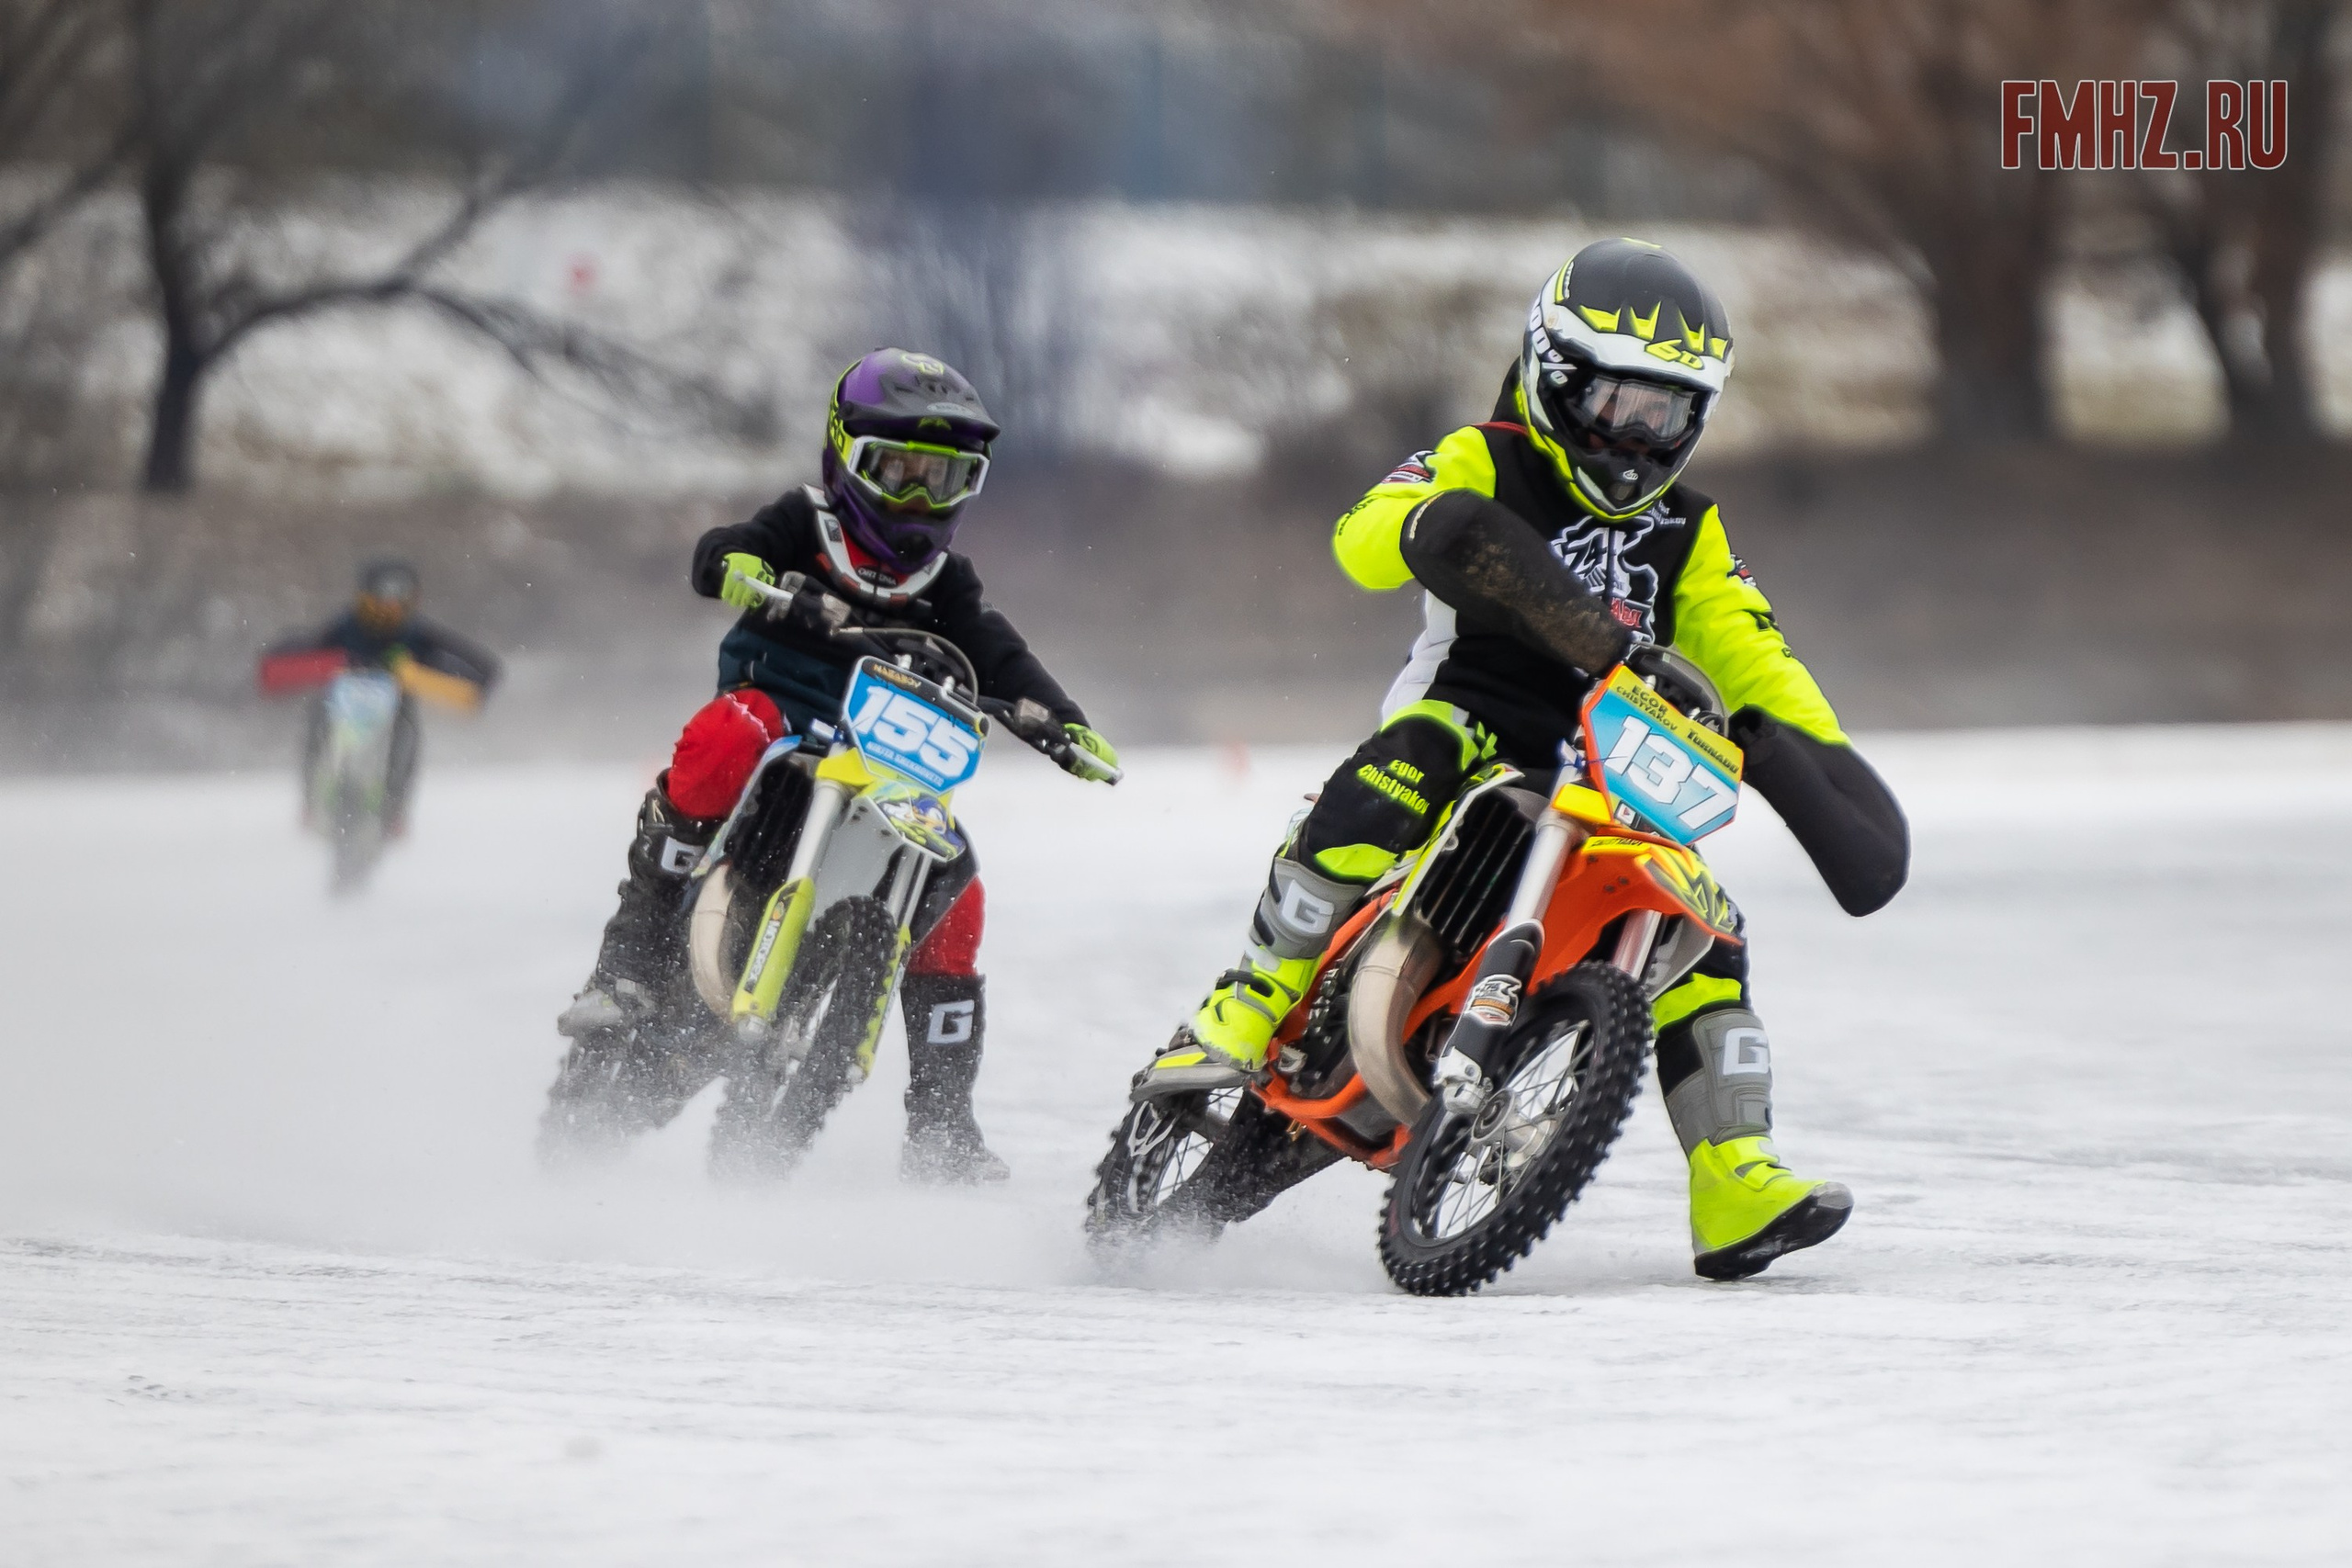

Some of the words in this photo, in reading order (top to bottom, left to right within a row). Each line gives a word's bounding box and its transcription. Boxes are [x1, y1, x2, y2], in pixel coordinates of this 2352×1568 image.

[1616, 686, 1678, 732] CHISTYAKOV
[1632, 684, 1668, 715] EGOR
[852, 685, 979, 778] 155
[1604, 715, 1739, 830] 137
[1282, 879, 1335, 934] G
[926, 998, 975, 1044] G
[1723, 1027, 1769, 1076] G
